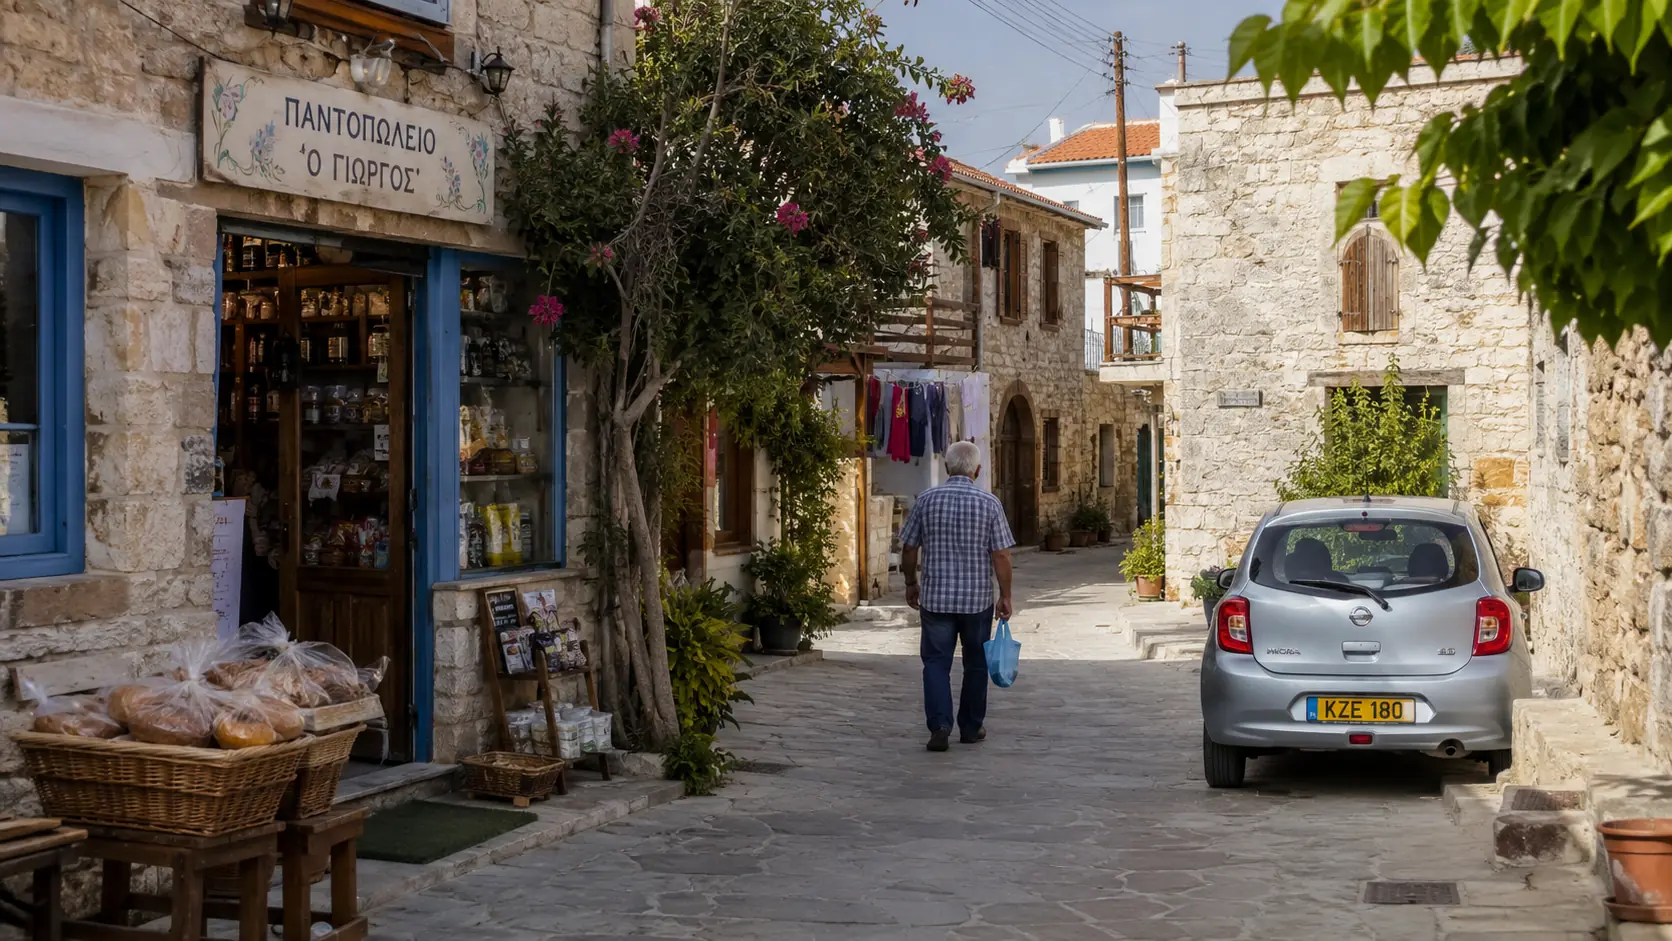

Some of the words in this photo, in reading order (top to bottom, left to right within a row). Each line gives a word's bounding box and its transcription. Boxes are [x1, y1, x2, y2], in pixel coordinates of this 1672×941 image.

[285, 97, 436, 155] ΠΑΝΤΟΠΩΛΕΙΟ
[1325, 700, 1362, 719] KZE
[1370, 701, 1403, 719] 180
